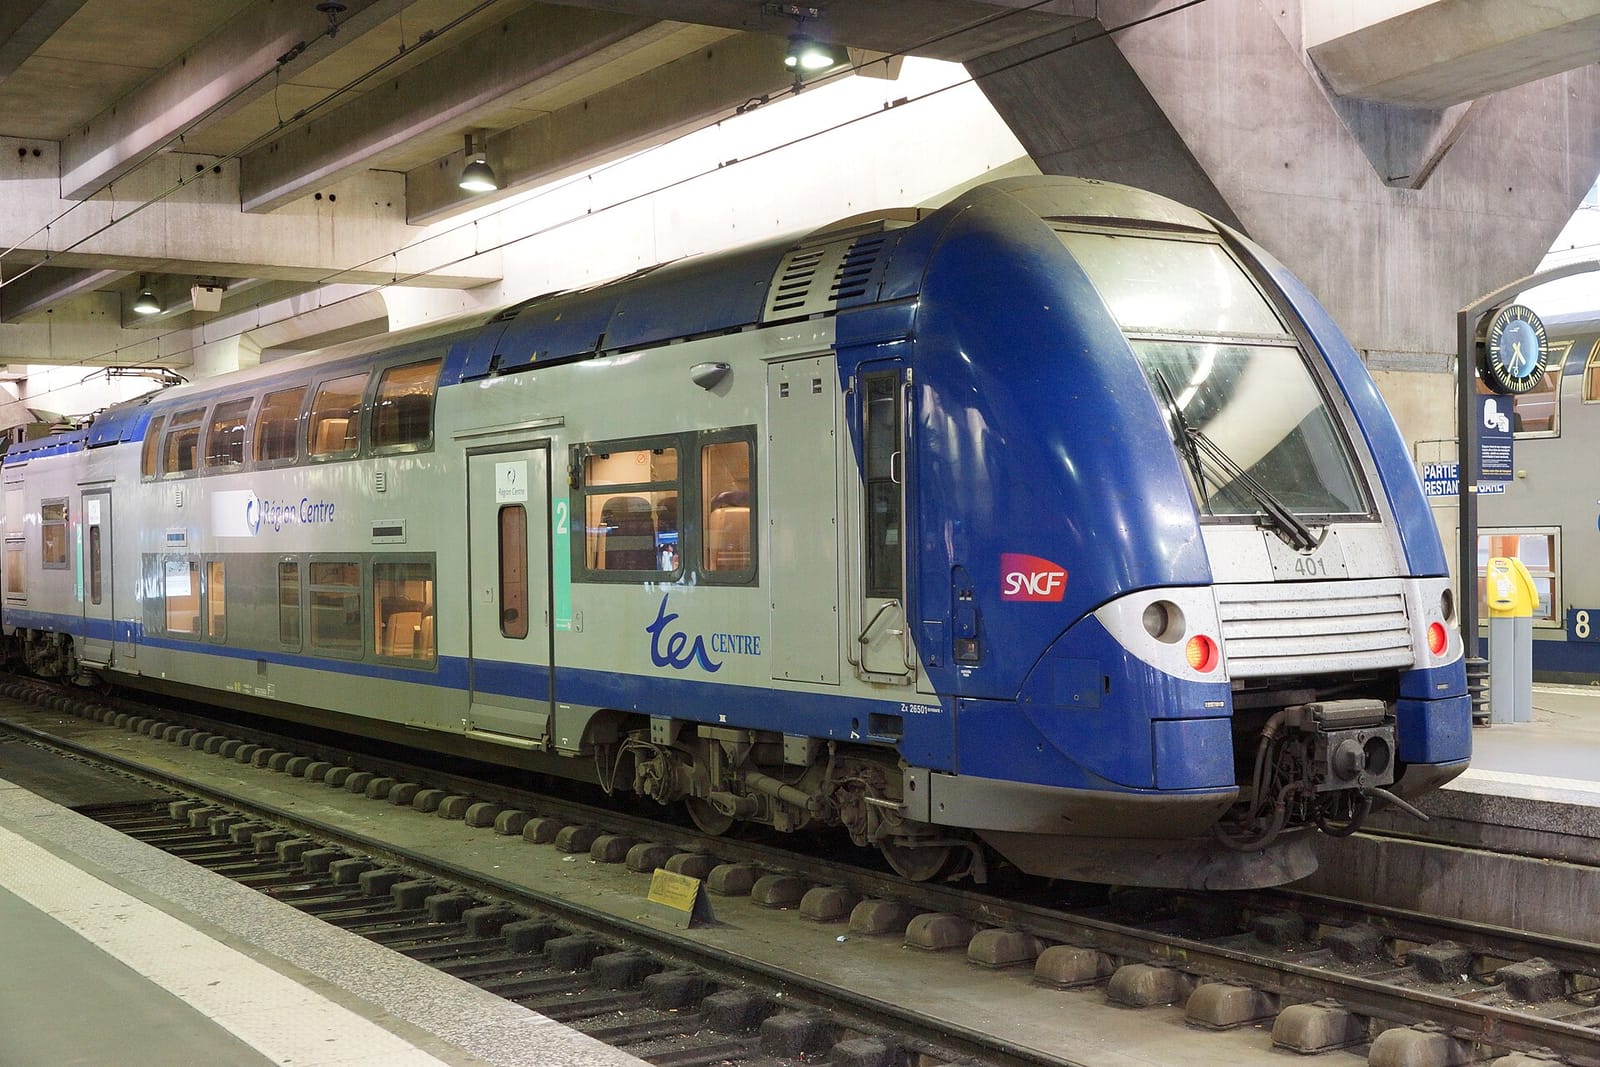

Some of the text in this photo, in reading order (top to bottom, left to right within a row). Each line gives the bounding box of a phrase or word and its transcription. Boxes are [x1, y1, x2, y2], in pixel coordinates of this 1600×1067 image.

[1424, 465, 1458, 479] PARTIE
[1425, 480, 1460, 495] RESTAN
[264, 498, 335, 532] Région Centre
[557, 502, 567, 534] 2
[1295, 557, 1326, 576] 401
[1004, 572, 1065, 595] SNCF
[645, 592, 761, 673] ter CENTRE
[1575, 610, 1590, 639] 8
[909, 704, 928, 714] 26501
